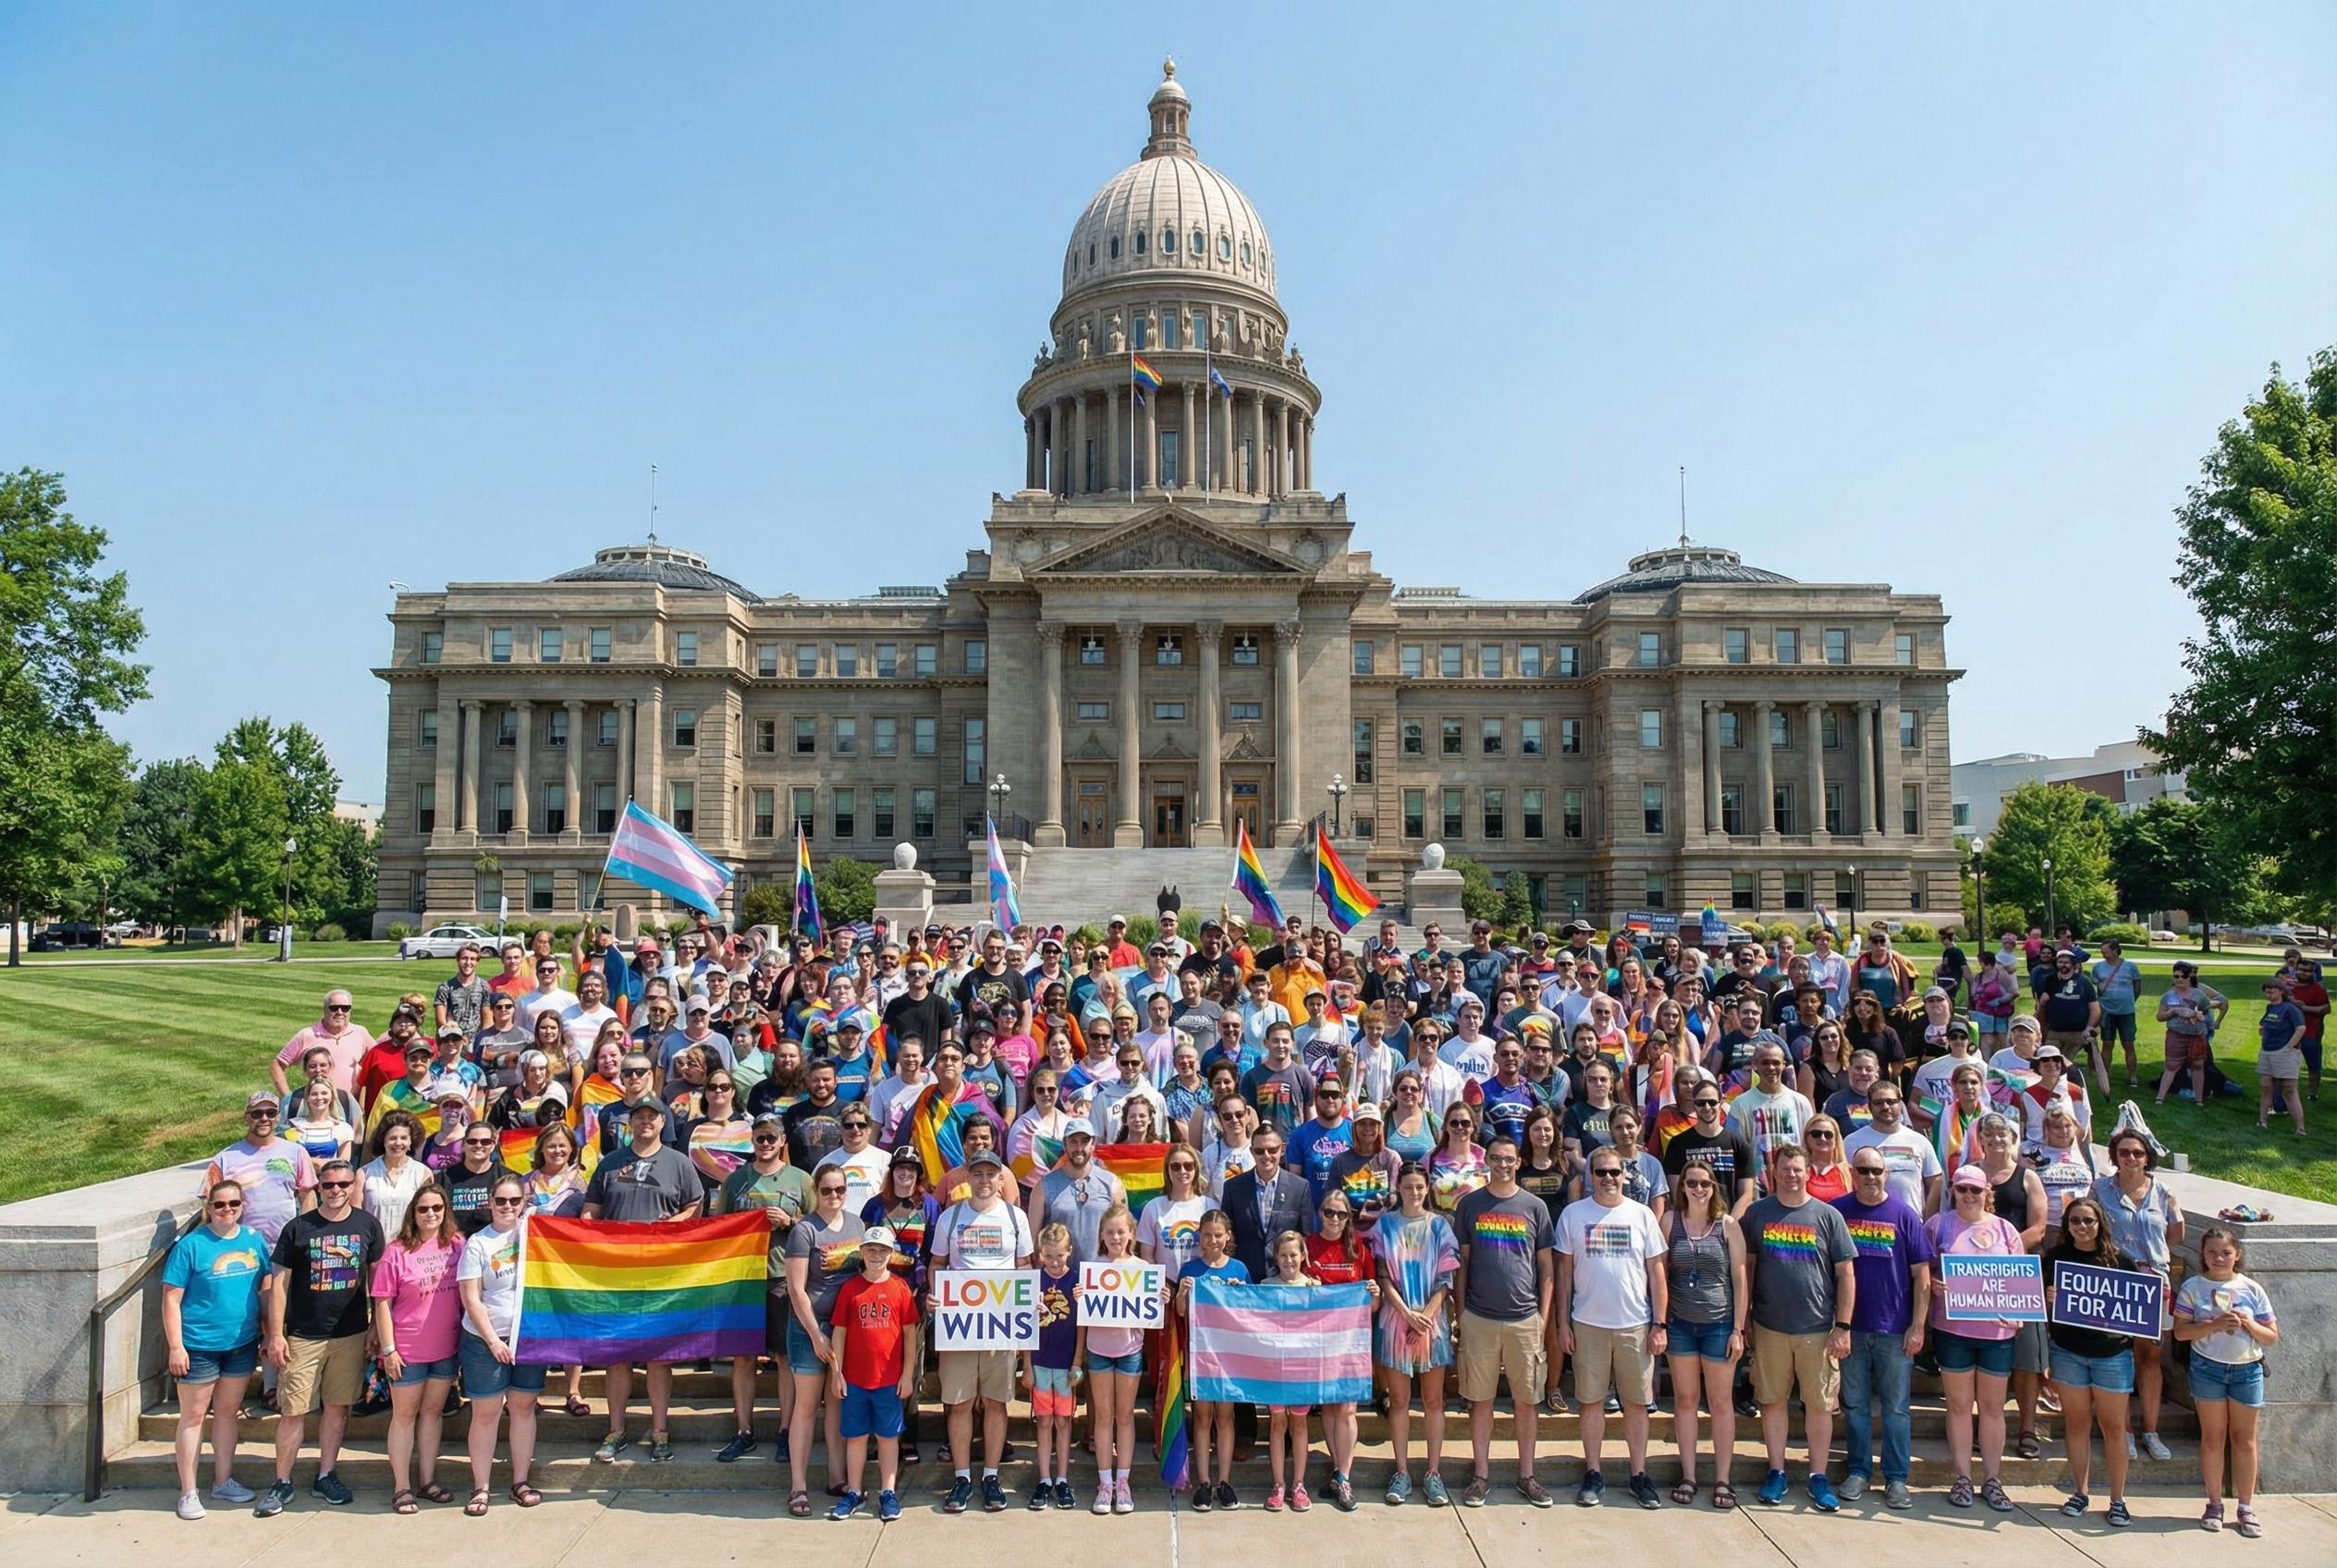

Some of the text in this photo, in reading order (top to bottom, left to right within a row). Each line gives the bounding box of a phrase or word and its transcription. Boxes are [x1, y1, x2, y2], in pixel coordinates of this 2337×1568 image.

[1085, 1268, 1158, 1292] LOVE
[1950, 1262, 2035, 1278] TRANSRIGHTS
[943, 1279, 1032, 1306] LOVE
[1982, 1279, 2007, 1292] ARE
[2061, 1271, 2157, 1305] EQUALITY
[1084, 1294, 1158, 1320] WINS
[1950, 1293, 2041, 1309] HUMAN RIGHTS
[2067, 1294, 2105, 1318] FOR
[2111, 1305, 2148, 1325] ALL
[942, 1311, 1033, 1340] WINS
